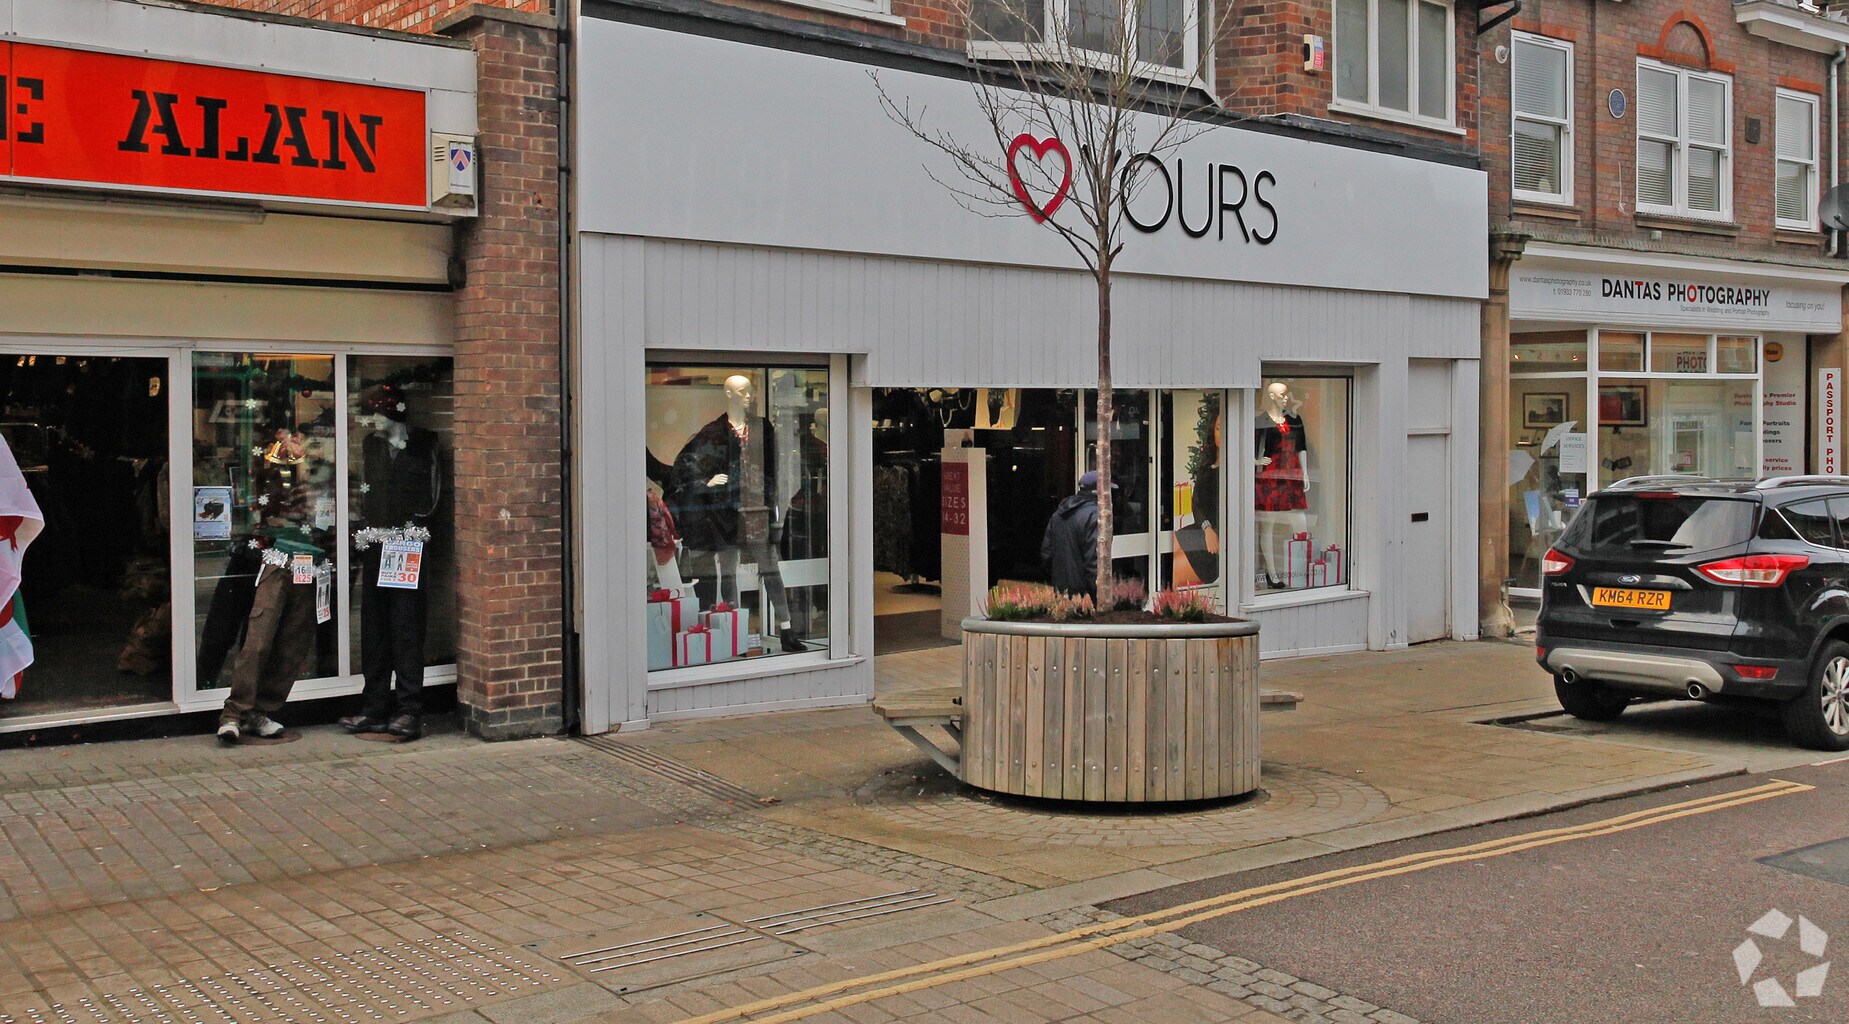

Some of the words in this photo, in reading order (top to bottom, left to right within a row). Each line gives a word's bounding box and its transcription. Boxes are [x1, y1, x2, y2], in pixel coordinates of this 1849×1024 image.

[0, 75, 44, 144] E
[118, 89, 383, 173] ALAN
[1602, 279, 1661, 301] DANTAS
[1668, 283, 1770, 306] PHOTOGRAPHY
[1785, 300, 1806, 311] focusing
[1826, 373, 1834, 443] PASSPORT
[1826, 448, 1834, 474] PHO
[1599, 589, 1633, 604] KM64
[1637, 592, 1664, 606] RZR
